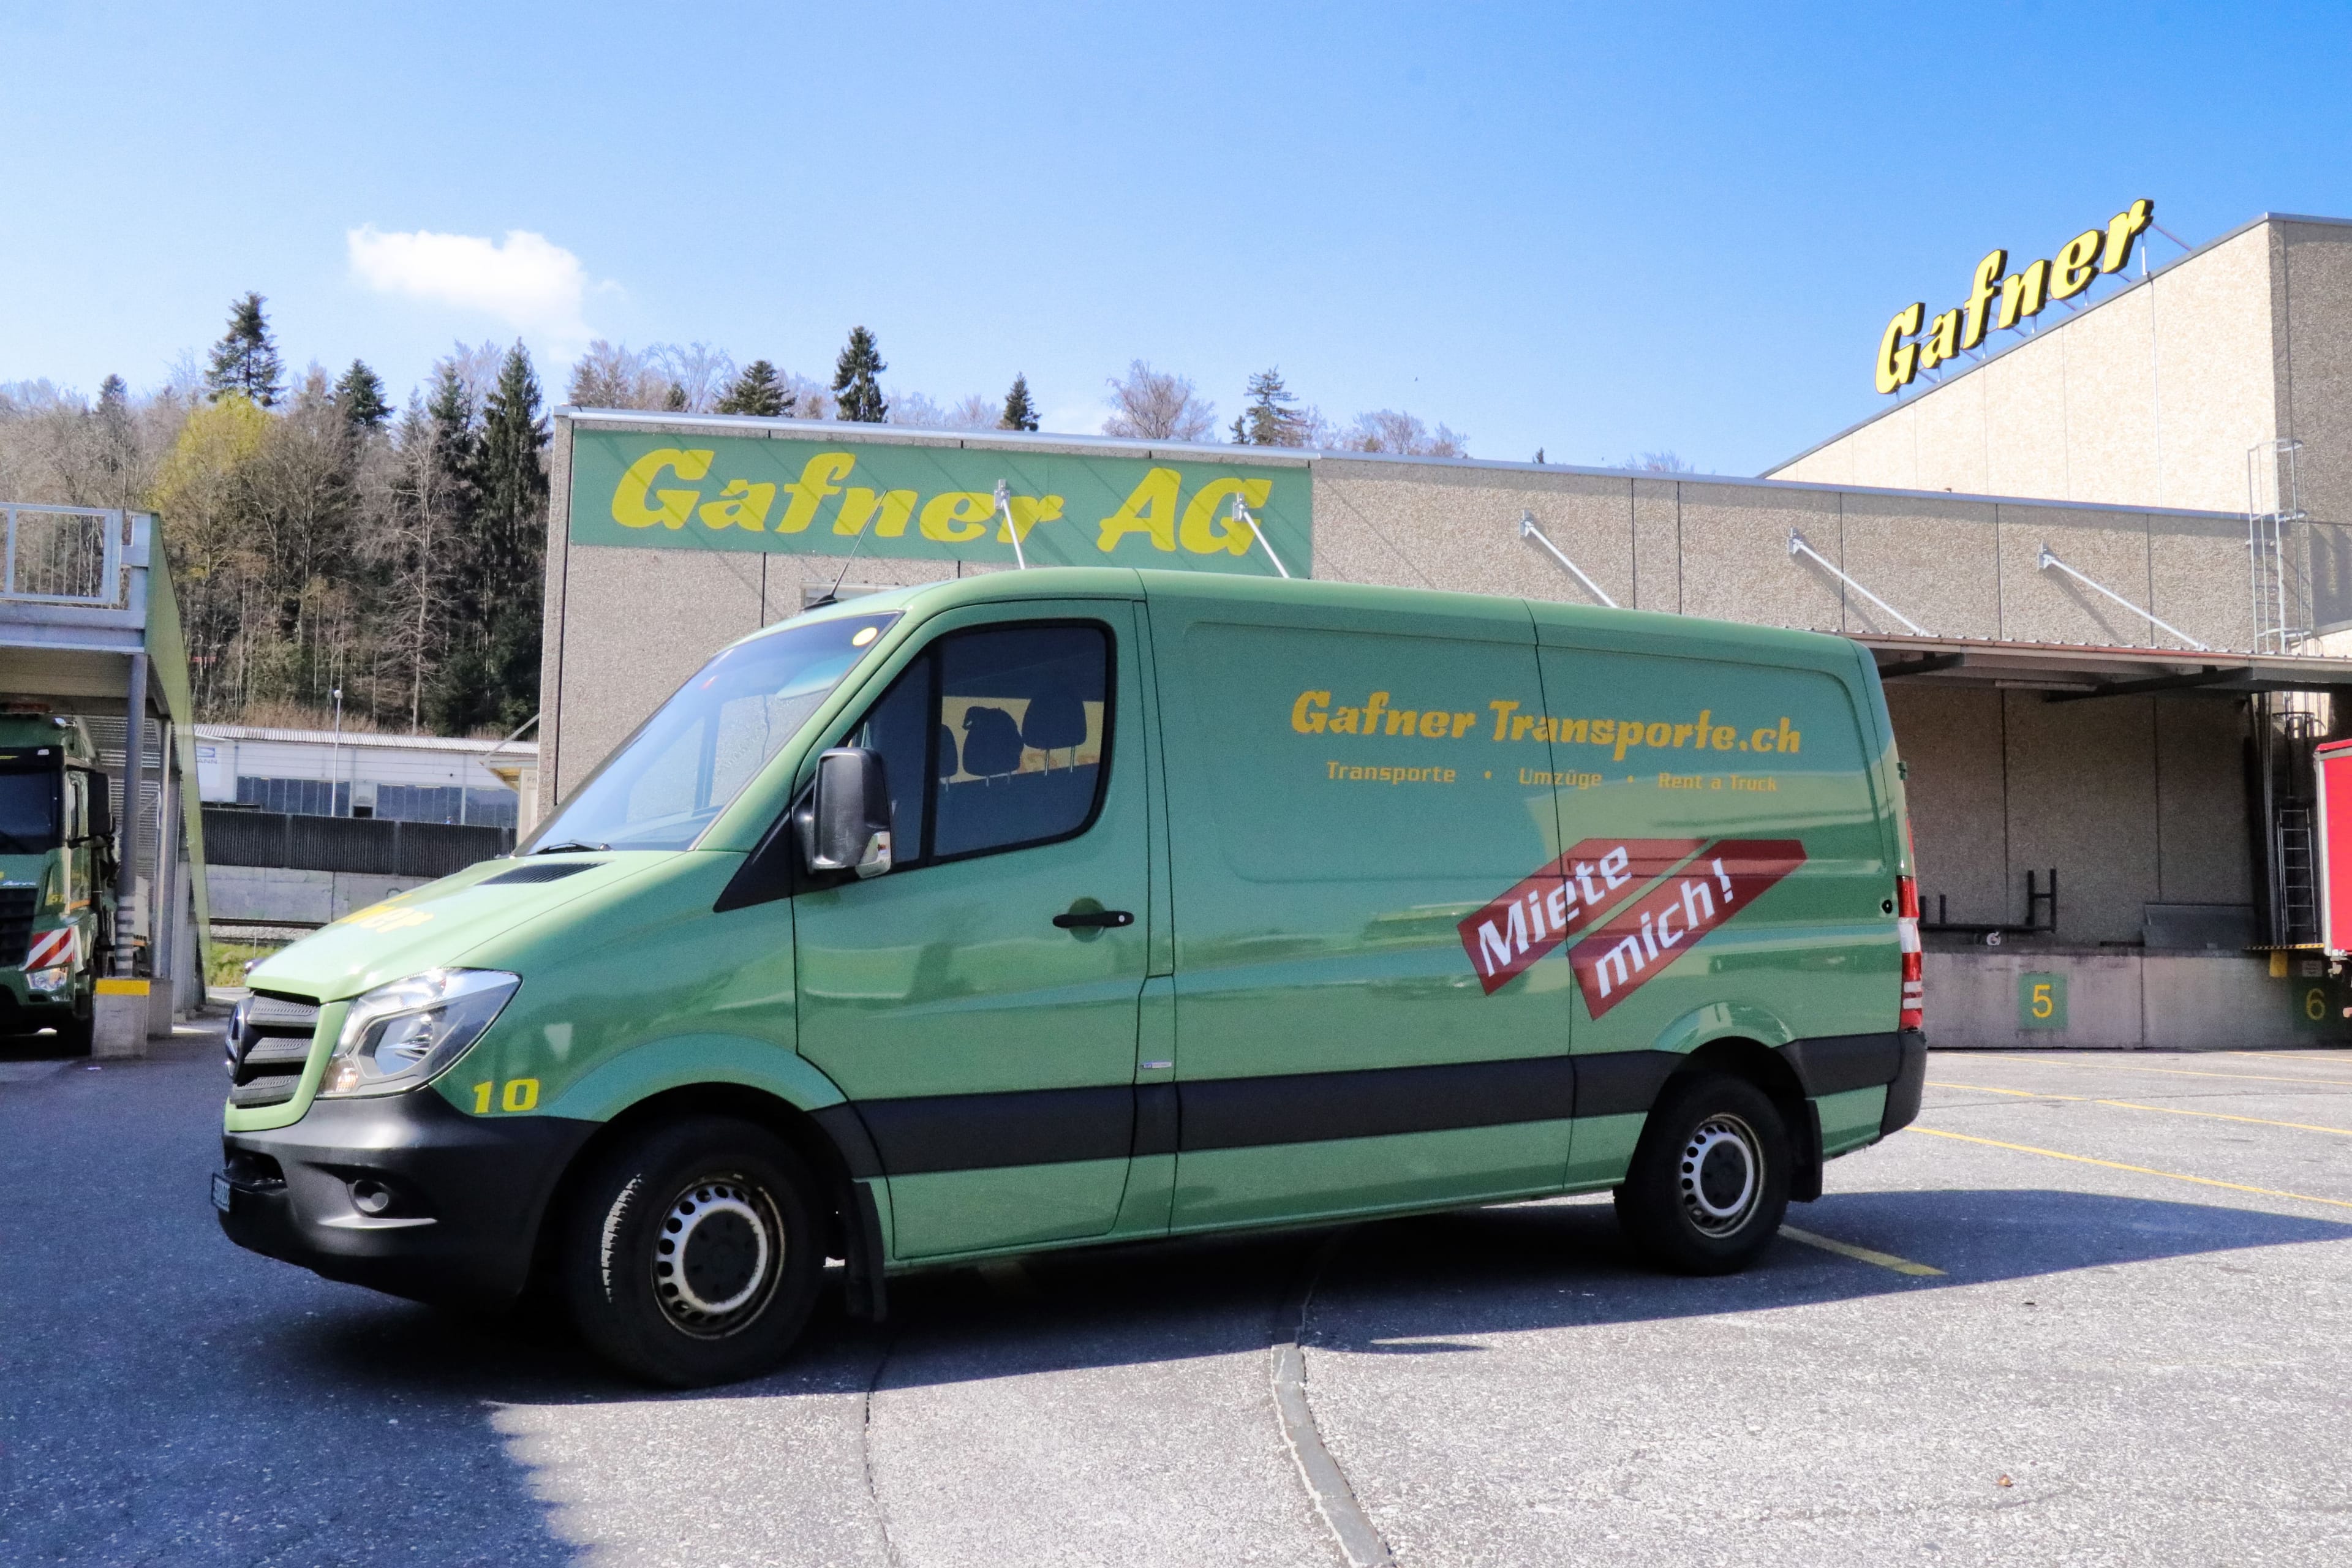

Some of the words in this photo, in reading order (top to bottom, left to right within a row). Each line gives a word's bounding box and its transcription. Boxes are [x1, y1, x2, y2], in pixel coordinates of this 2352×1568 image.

[1875, 198, 2154, 394] Gafner
[611, 448, 1065, 544] Gafner
[1097, 467, 1273, 556] AG
[1291, 690, 1477, 739] Gafner
[1489, 700, 1801, 761] Transporte.ch
[1327, 761, 1456, 785] Transporte
[1519, 768, 1602, 790] Umzüge
[1658, 772, 1702, 790] Rent
[1709, 778, 1722, 790] a
[1730, 774, 1778, 792] Truck
[1478, 846, 1632, 978] Miete
[1596, 857, 1733, 999] mich!
[2032, 984, 2053, 1019] 5
[2306, 988, 2326, 1020] 6
[473, 1078, 540, 1114] 10
